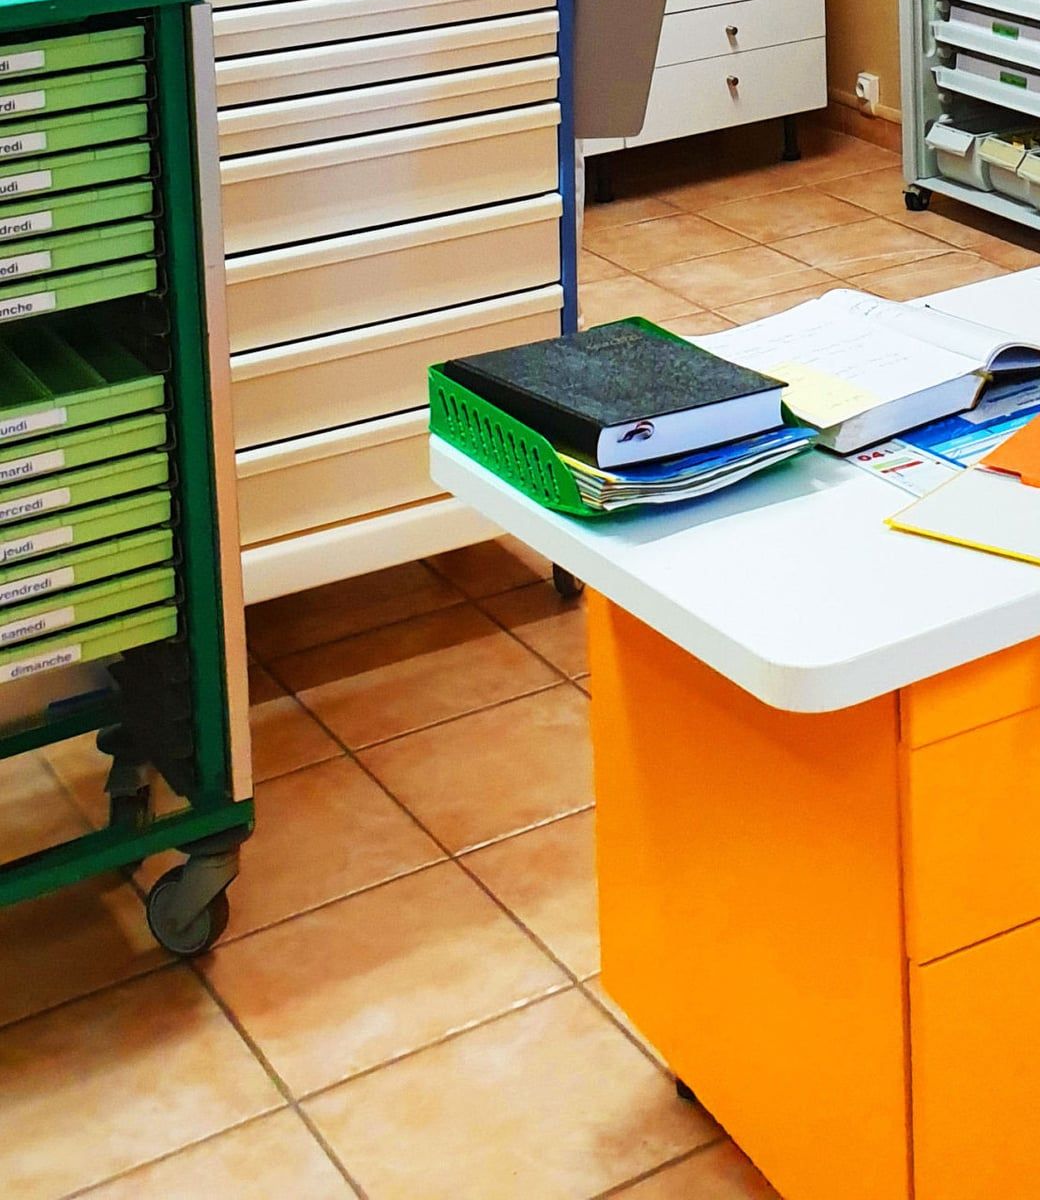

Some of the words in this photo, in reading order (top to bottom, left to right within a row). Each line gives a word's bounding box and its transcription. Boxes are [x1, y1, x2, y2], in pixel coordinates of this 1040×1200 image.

[2, 540, 34, 560] jeudi
[1, 619, 46, 640] samedi
[10, 652, 72, 678] dimanche
